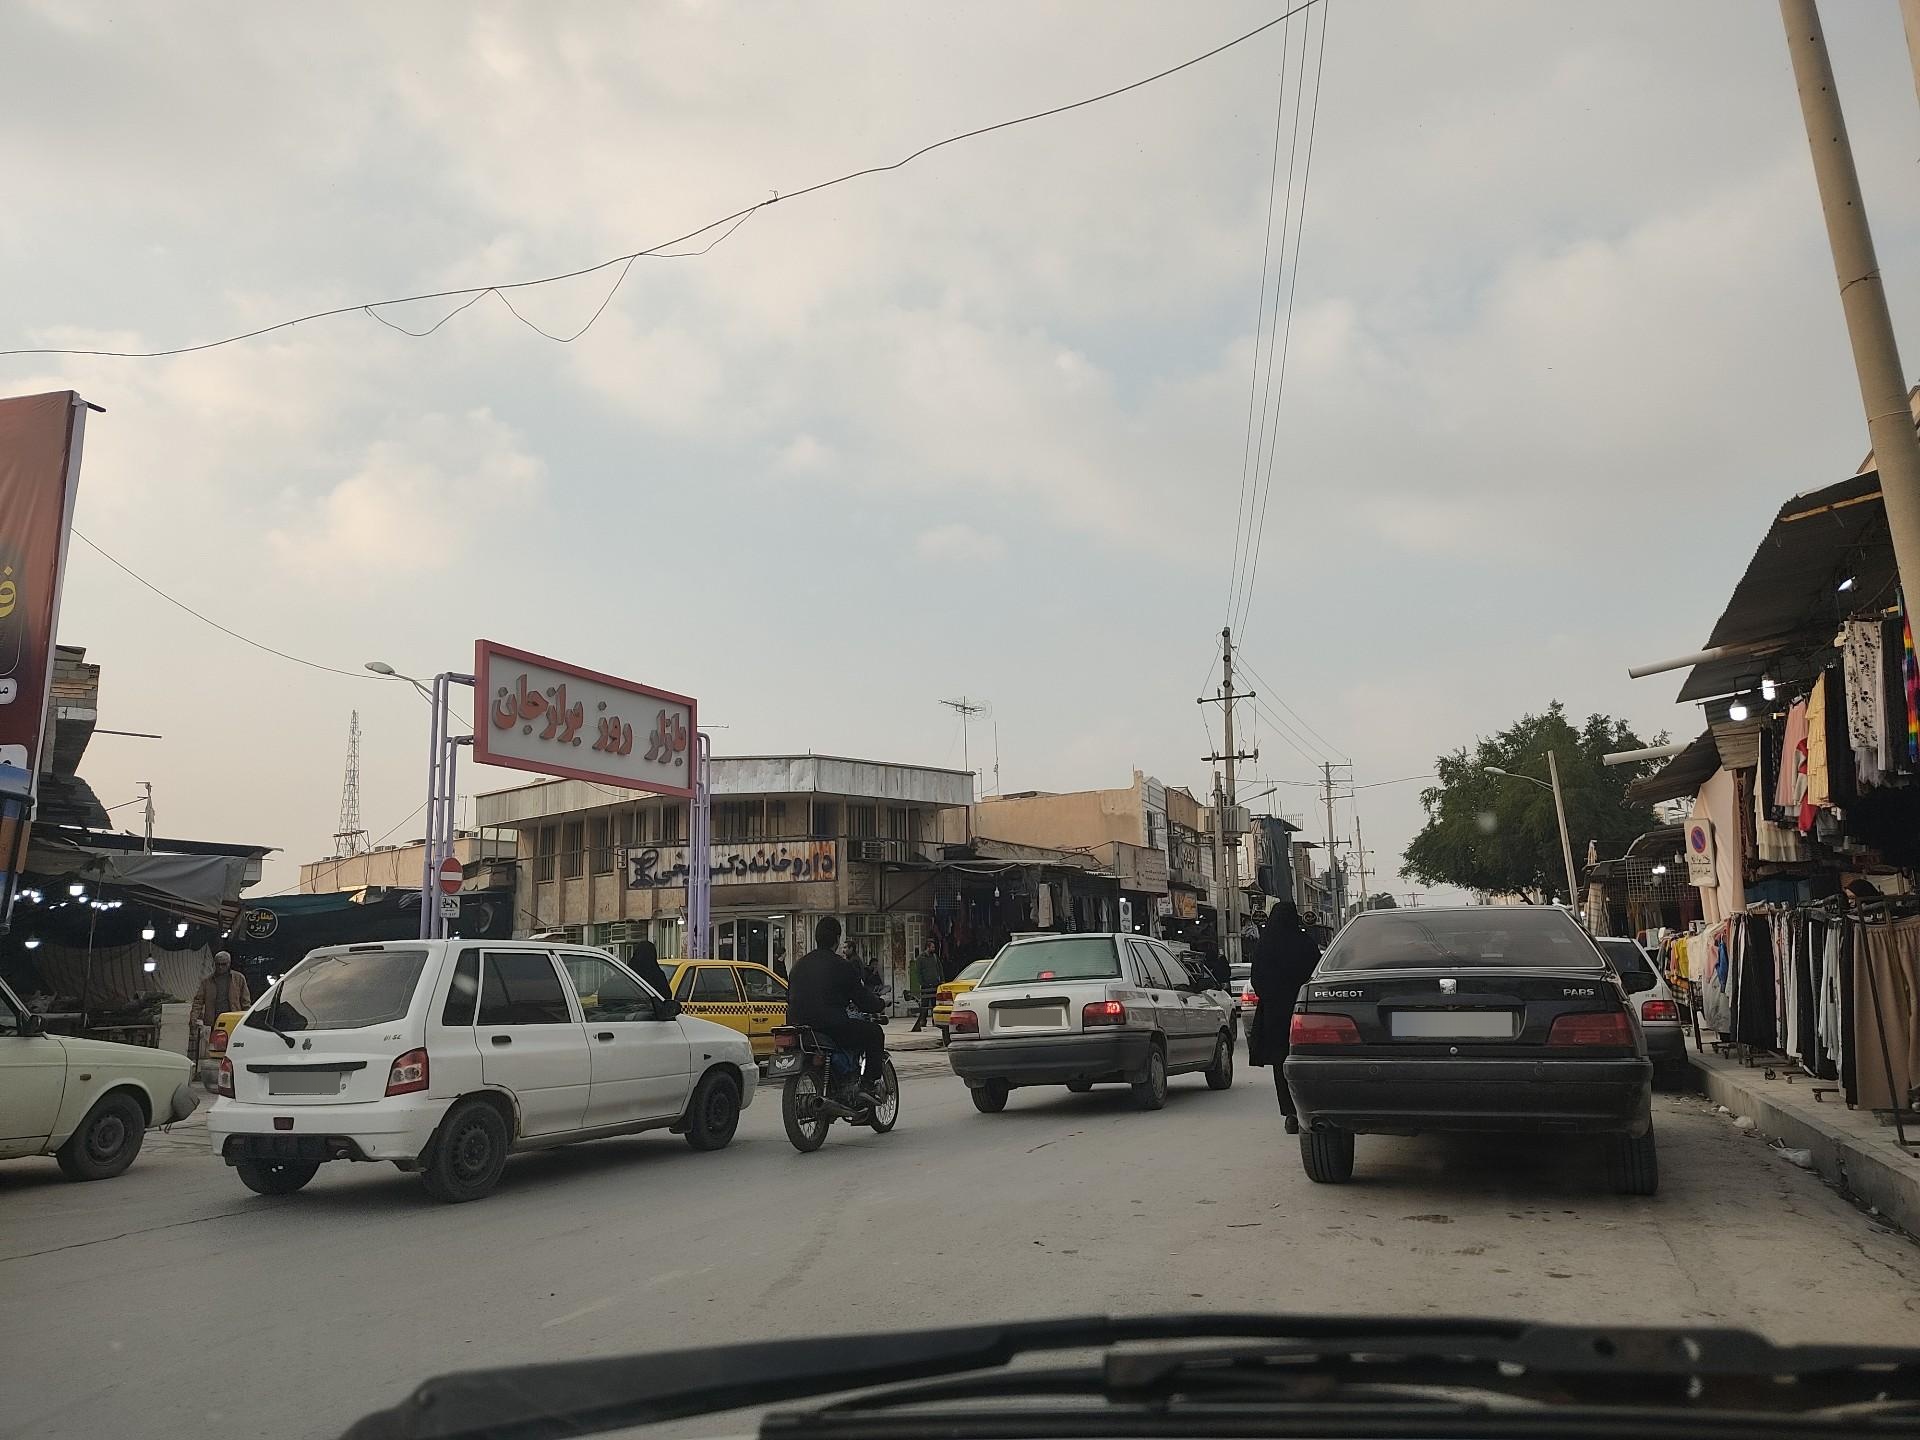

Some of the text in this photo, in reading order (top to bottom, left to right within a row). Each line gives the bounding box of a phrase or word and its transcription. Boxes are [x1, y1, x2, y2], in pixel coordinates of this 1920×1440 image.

[491, 674, 687, 767] بازار روز برازجان
[748, 847, 834, 877] داروخانه
[1314, 989, 1364, 998] PEUGEOT
[1563, 987, 1595, 996] PARS
